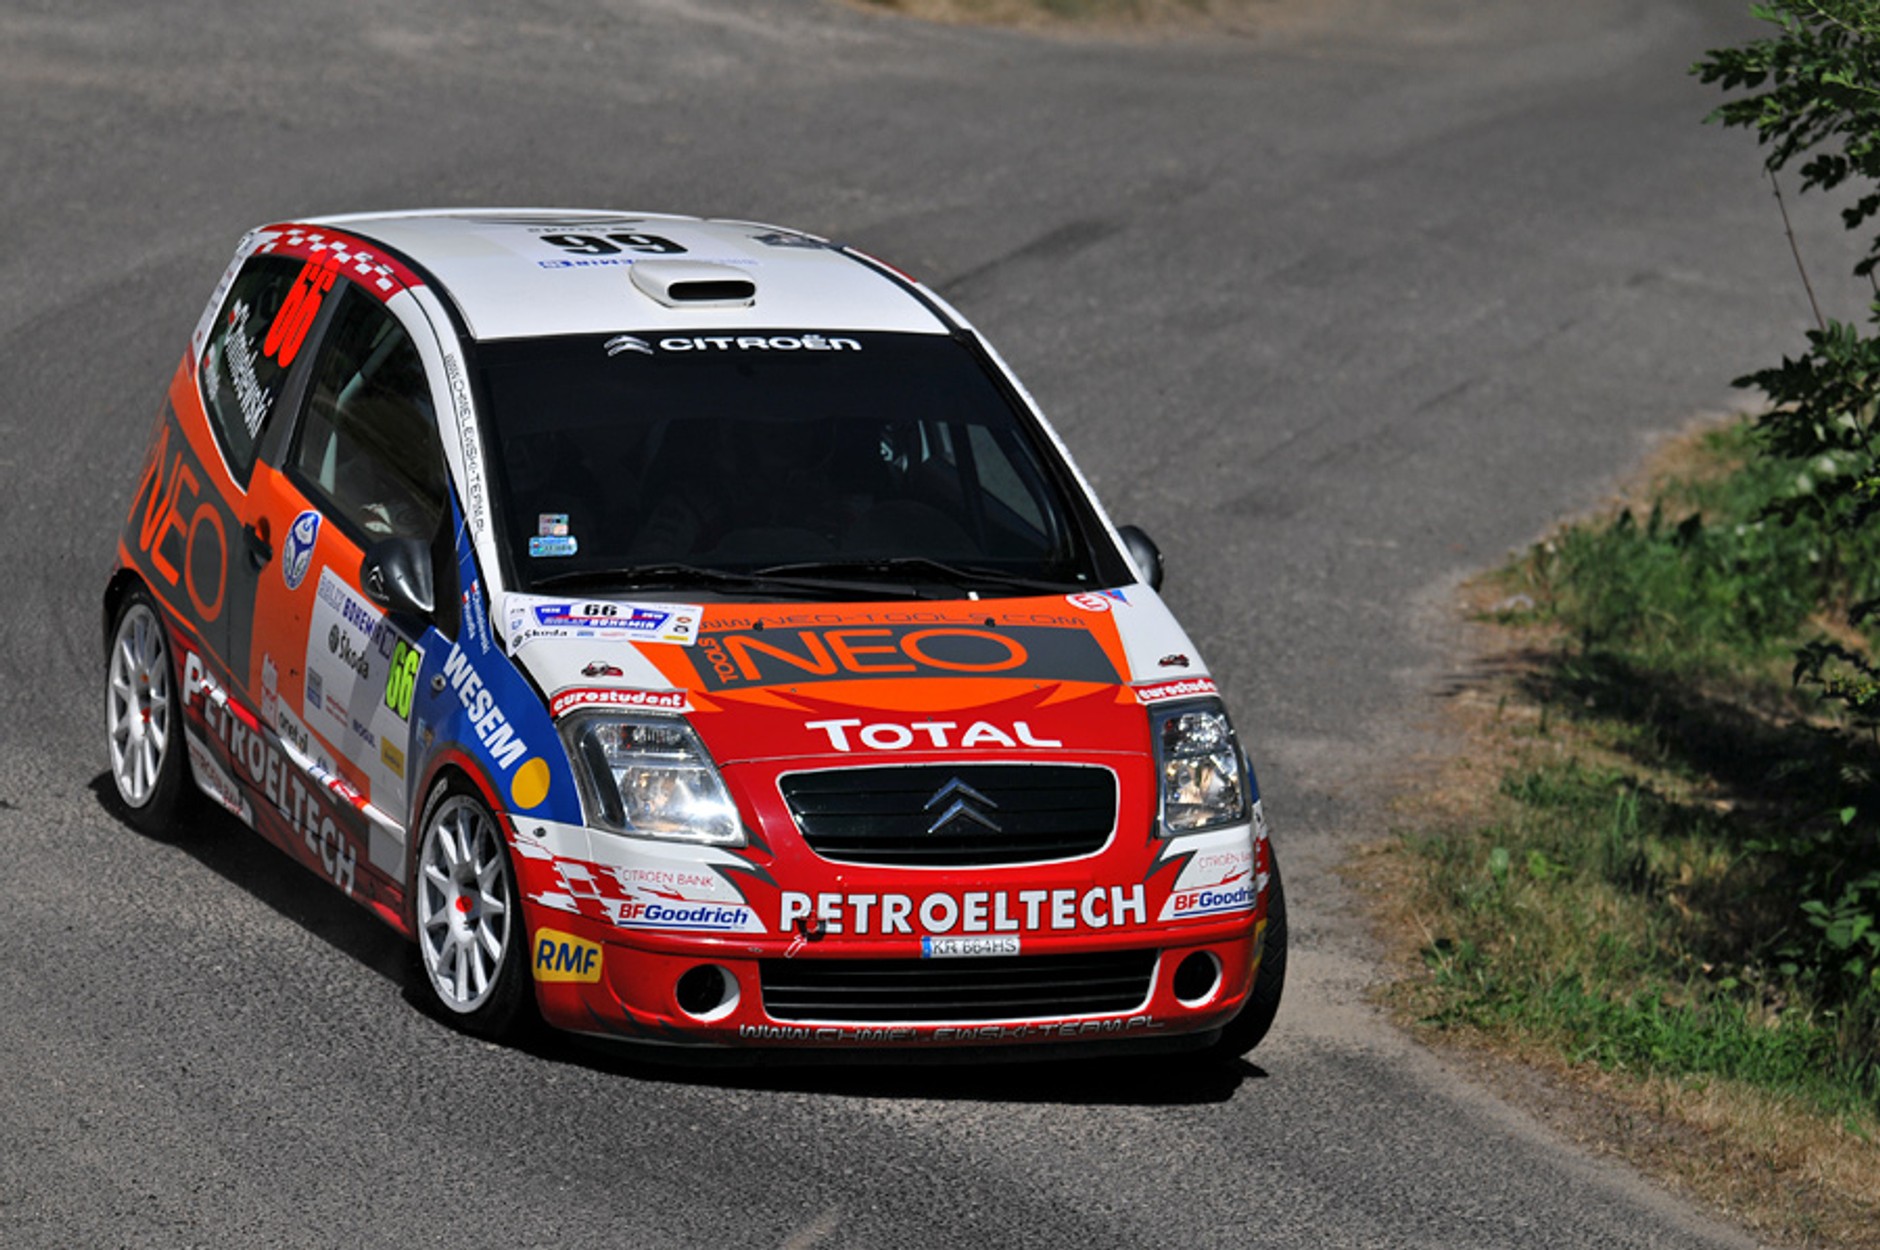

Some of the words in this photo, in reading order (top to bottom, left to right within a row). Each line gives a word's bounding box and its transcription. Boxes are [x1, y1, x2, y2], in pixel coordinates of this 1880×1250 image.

[263, 249, 340, 368] 66
[127, 424, 228, 624] NEO
[583, 603, 618, 617] 66
[697, 637, 739, 684] TOOLS
[722, 628, 1028, 681] NEO
[386, 640, 420, 720] 66
[553, 688, 682, 711] eurostudent
[442, 641, 528, 770] WESEM
[804, 718, 1062, 752] TOTAL
[183, 650, 357, 896] PETROELTECH
[677, 874, 715, 888] BANK
[619, 902, 748, 926] BFGoodrich
[779, 883, 1147, 934] PETROELTECH
[537, 938, 599, 975] RMF
[933, 939, 958, 955] KR
